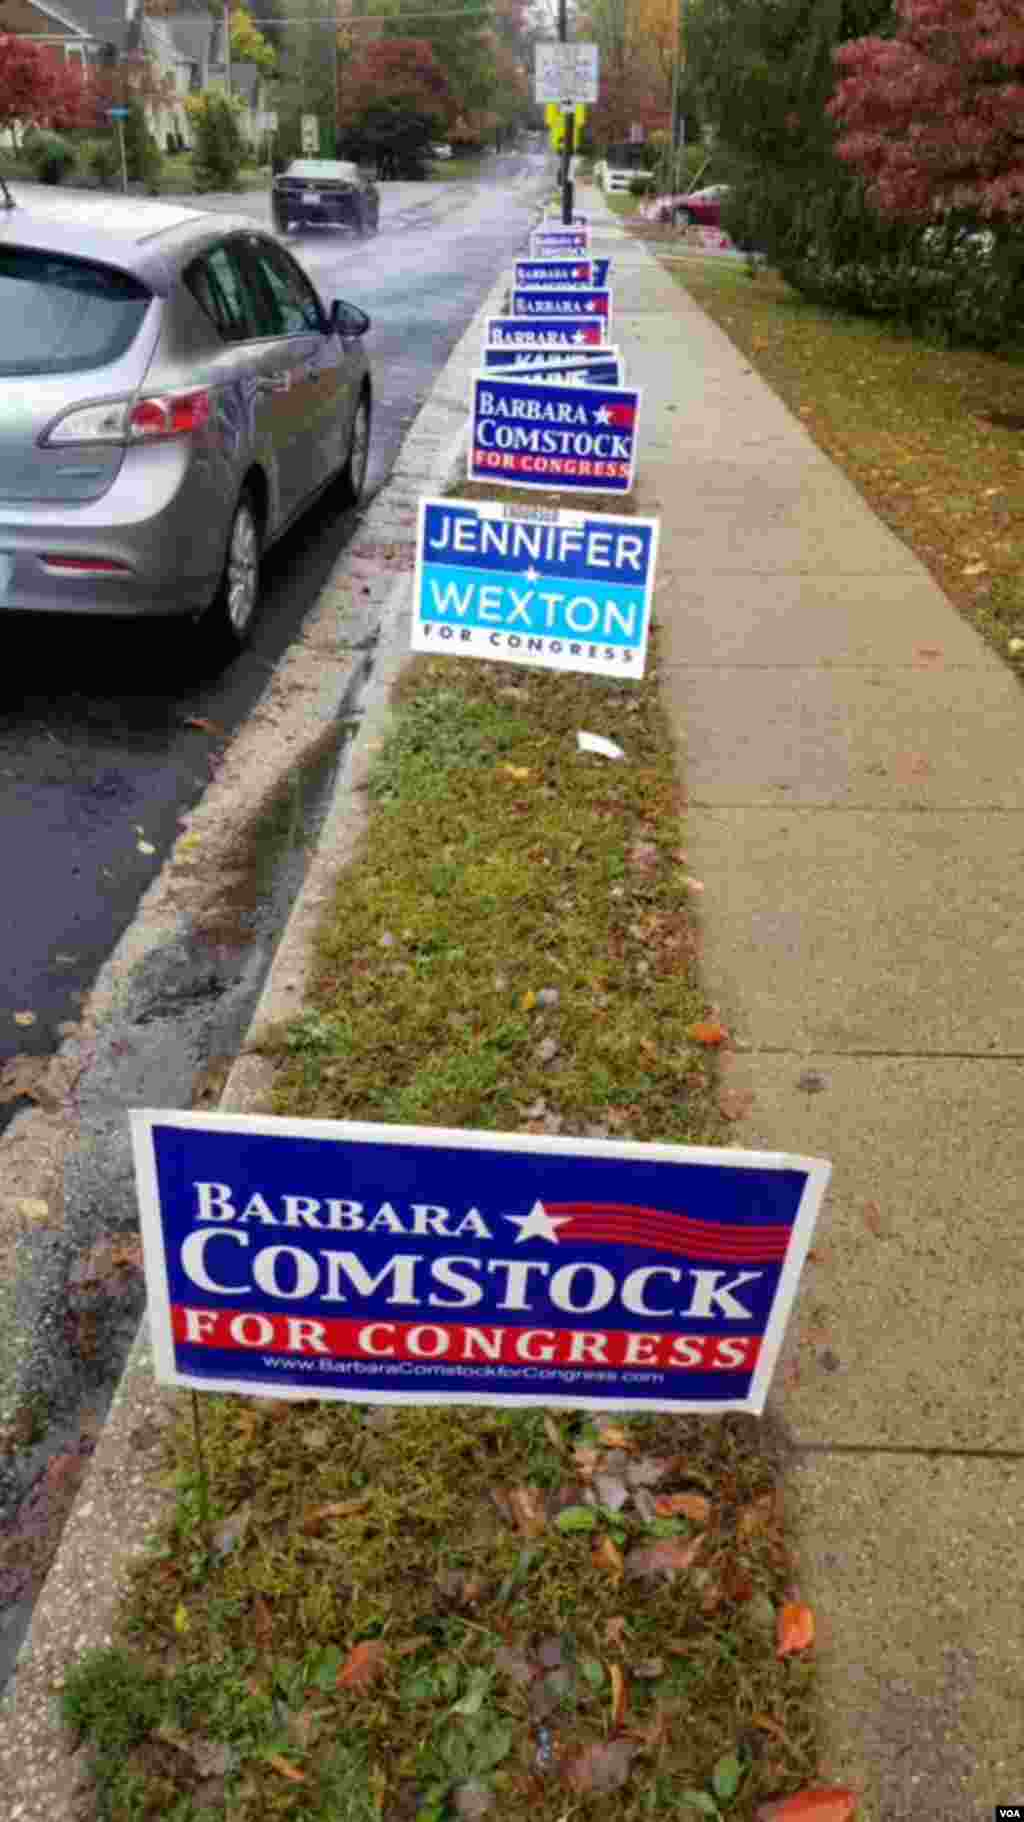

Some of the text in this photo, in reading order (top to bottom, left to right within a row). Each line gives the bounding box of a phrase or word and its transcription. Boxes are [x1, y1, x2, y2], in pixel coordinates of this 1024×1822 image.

[516, 298, 582, 313] BARBARA
[491, 329, 570, 344] BARBARA
[479, 391, 588, 425] BARBARA
[477, 419, 630, 458] COMSTOCK
[475, 451, 629, 477] FOR CONGRESS
[429, 516, 643, 570] JENNIFER
[429, 578, 637, 638] WEXTON
[423, 623, 633, 662] FOR CONGRESS
[193, 1181, 493, 1239] BARBARA
[180, 1226, 763, 1320] COMSTOCK
[184, 1307, 752, 1370] FOR CONGRESS
